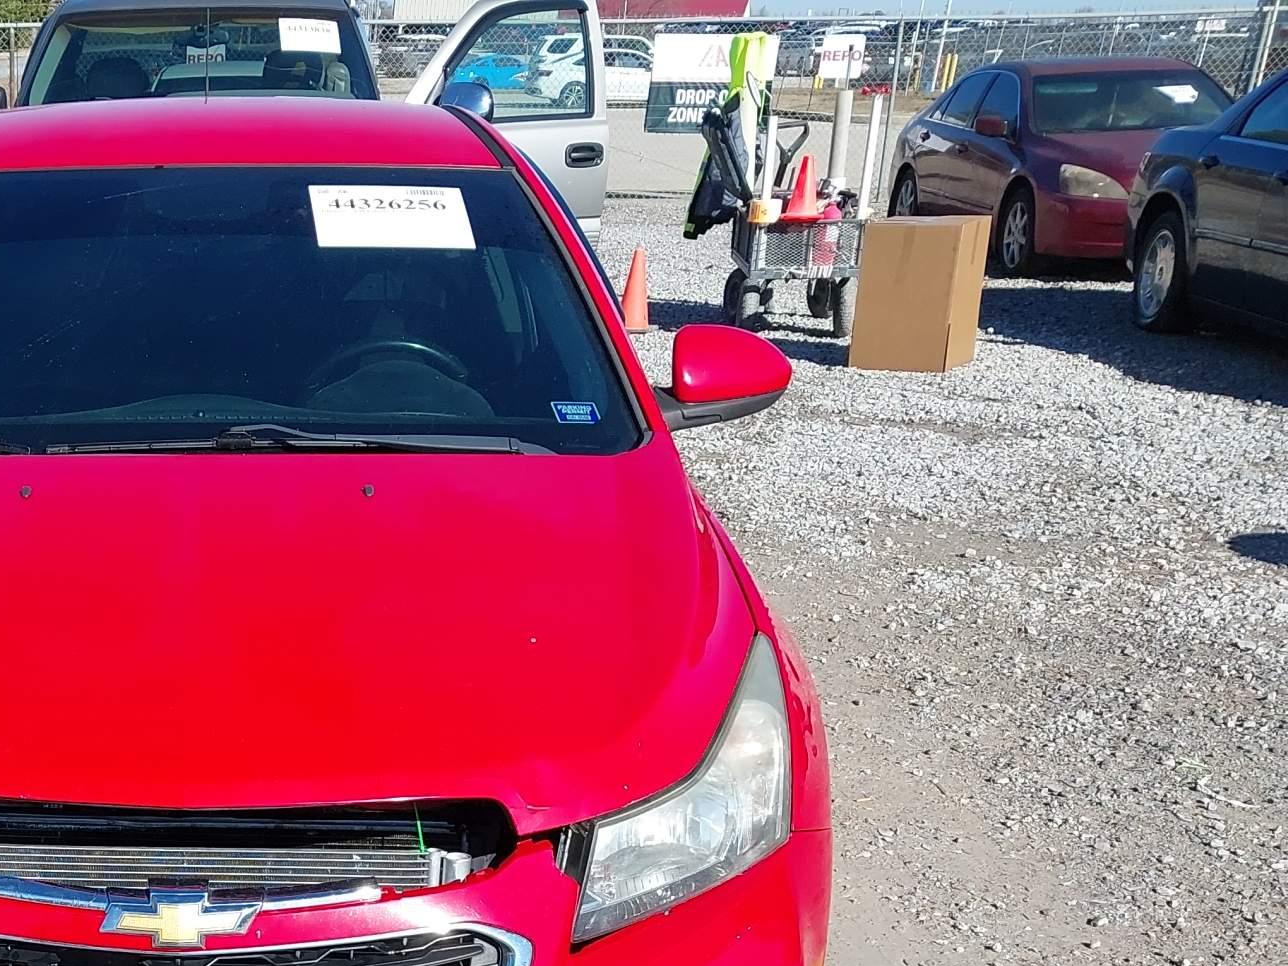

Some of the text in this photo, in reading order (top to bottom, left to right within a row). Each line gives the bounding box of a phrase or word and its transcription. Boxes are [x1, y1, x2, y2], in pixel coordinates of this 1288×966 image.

[822, 49, 863, 61] REPO
[675, 88, 717, 105] DROP
[328, 198, 447, 210] 44326256
